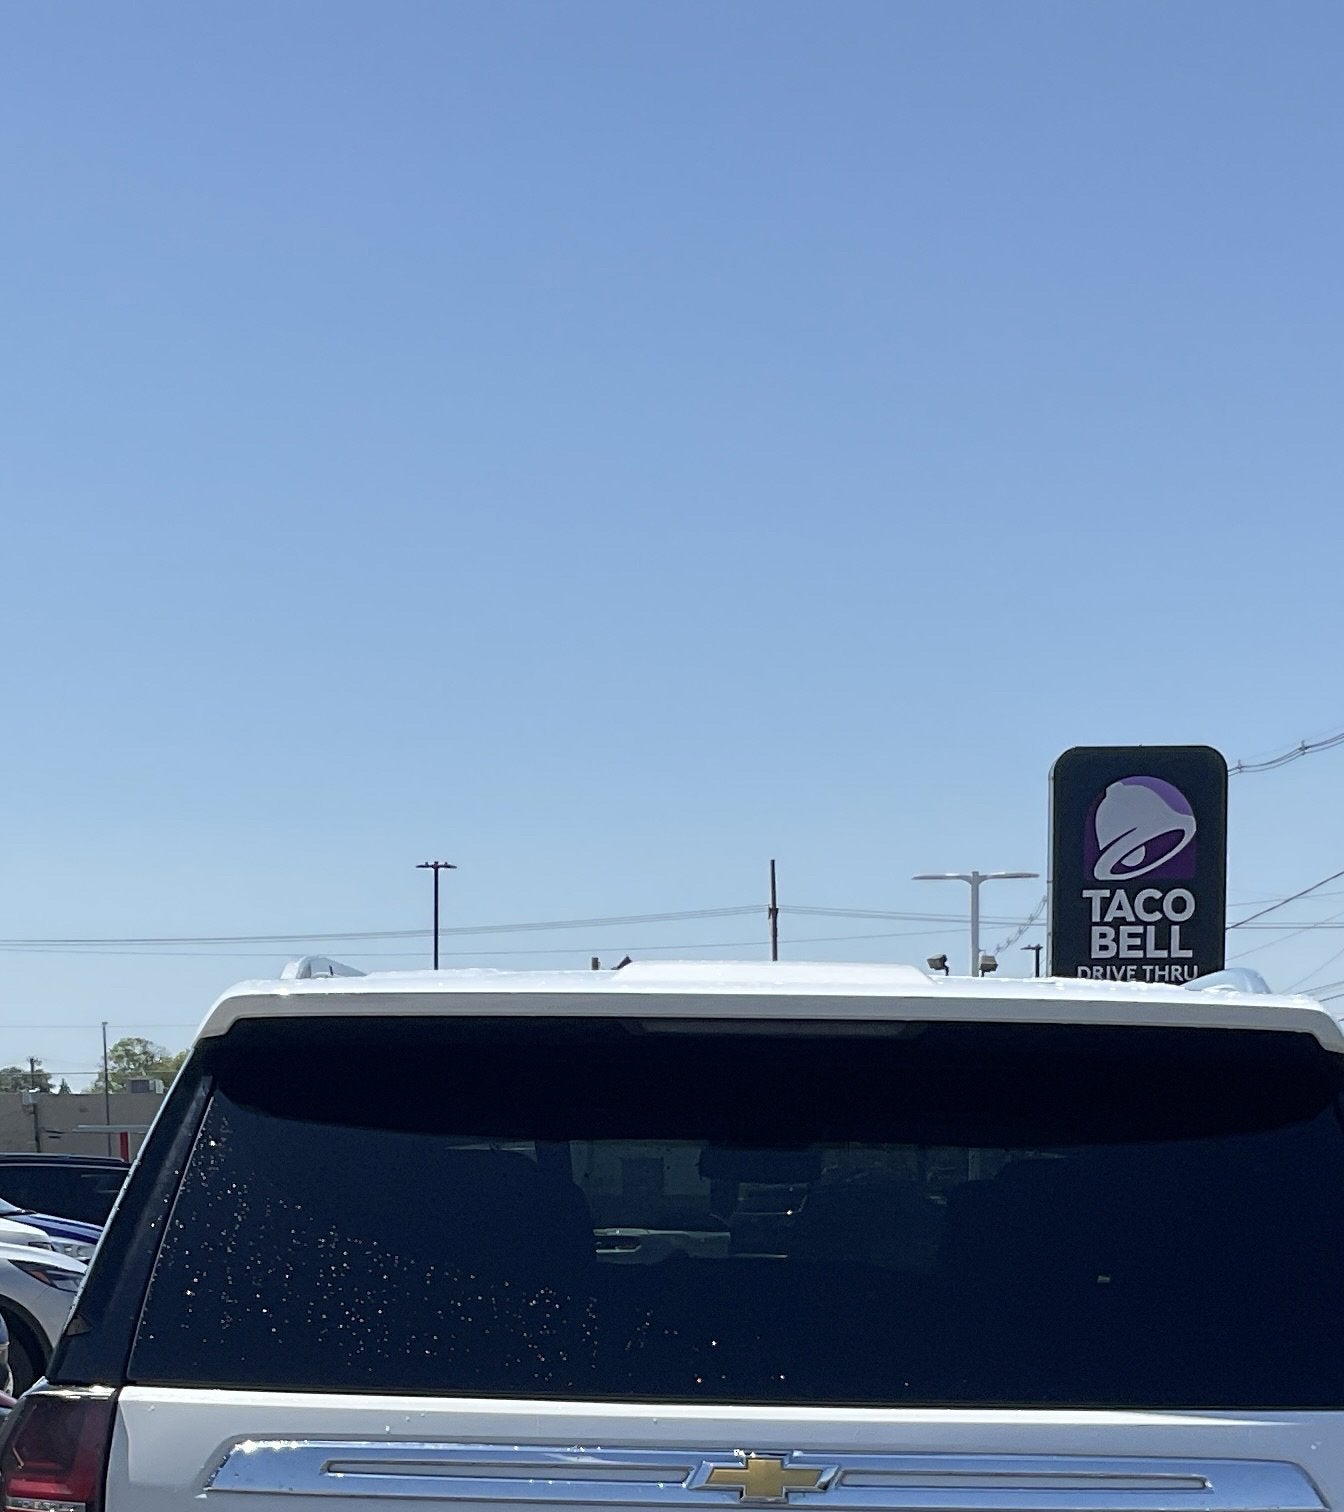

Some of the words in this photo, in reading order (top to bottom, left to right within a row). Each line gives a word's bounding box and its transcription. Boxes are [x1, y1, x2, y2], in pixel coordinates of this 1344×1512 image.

[1082, 888, 1195, 922] TACO
[1091, 925, 1193, 959] BELL
[1077, 965, 1137, 982] DRIVE
[1142, 965, 1198, 983] THRU
